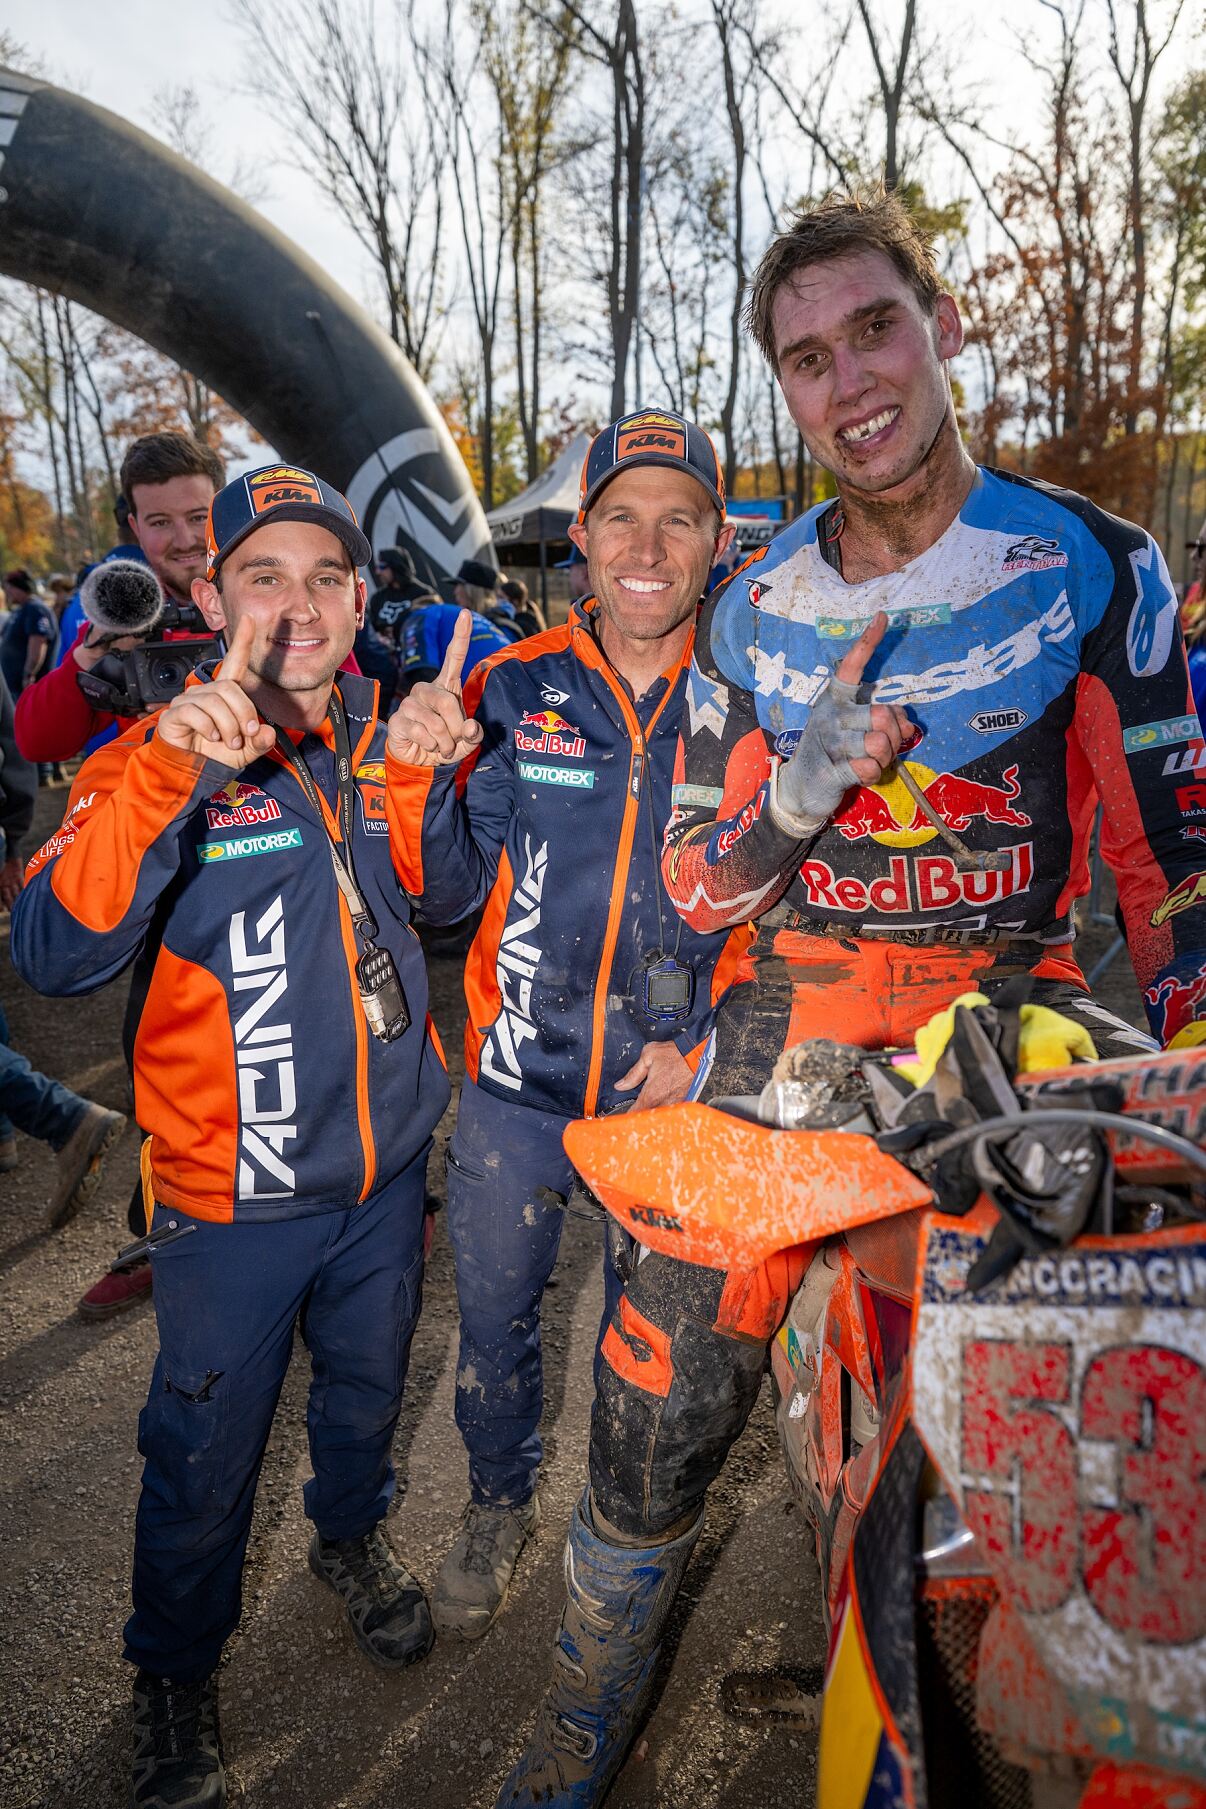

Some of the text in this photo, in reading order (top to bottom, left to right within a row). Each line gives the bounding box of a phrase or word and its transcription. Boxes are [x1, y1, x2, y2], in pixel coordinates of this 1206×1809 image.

[625, 433, 677, 450] KTM
[263, 488, 313, 504] KTM
[977, 712, 1019, 730] SHOEI
[515, 728, 587, 758] Red Bull
[520, 764, 590, 786] MOTOREX
[205, 798, 282, 830] Red Bull
[1181, 808, 1206, 818] TAKAS
[367, 821, 389, 831] FACTO
[225, 830, 299, 858] MOTOREX
[800, 841, 1034, 914] Red Bull
[961, 1338, 1206, 1646] 53
